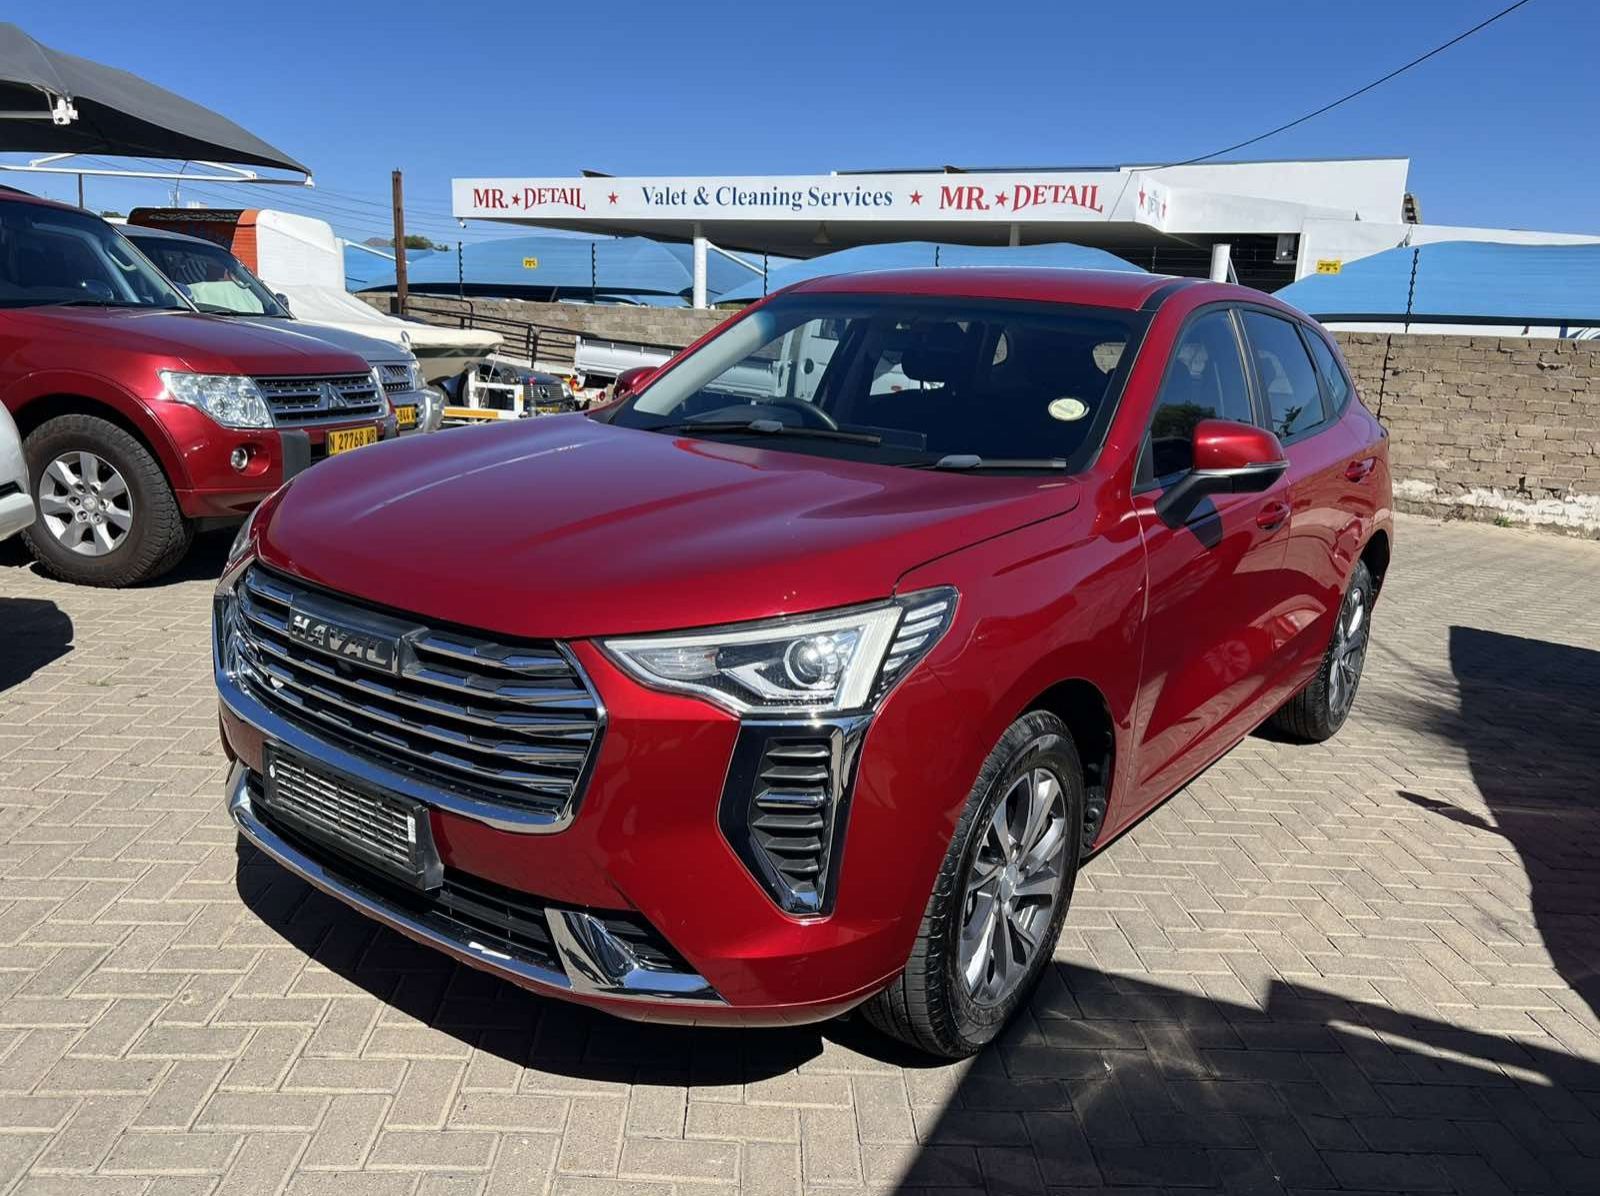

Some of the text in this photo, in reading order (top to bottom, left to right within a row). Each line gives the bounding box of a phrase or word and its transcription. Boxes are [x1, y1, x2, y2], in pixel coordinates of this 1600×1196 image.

[473, 187, 586, 210] MR. DETAIL
[641, 186, 893, 211] Valet & Cleaning Services
[939, 185, 1104, 213] MR. DETAIL
[292, 614, 388, 665] HAVAL
